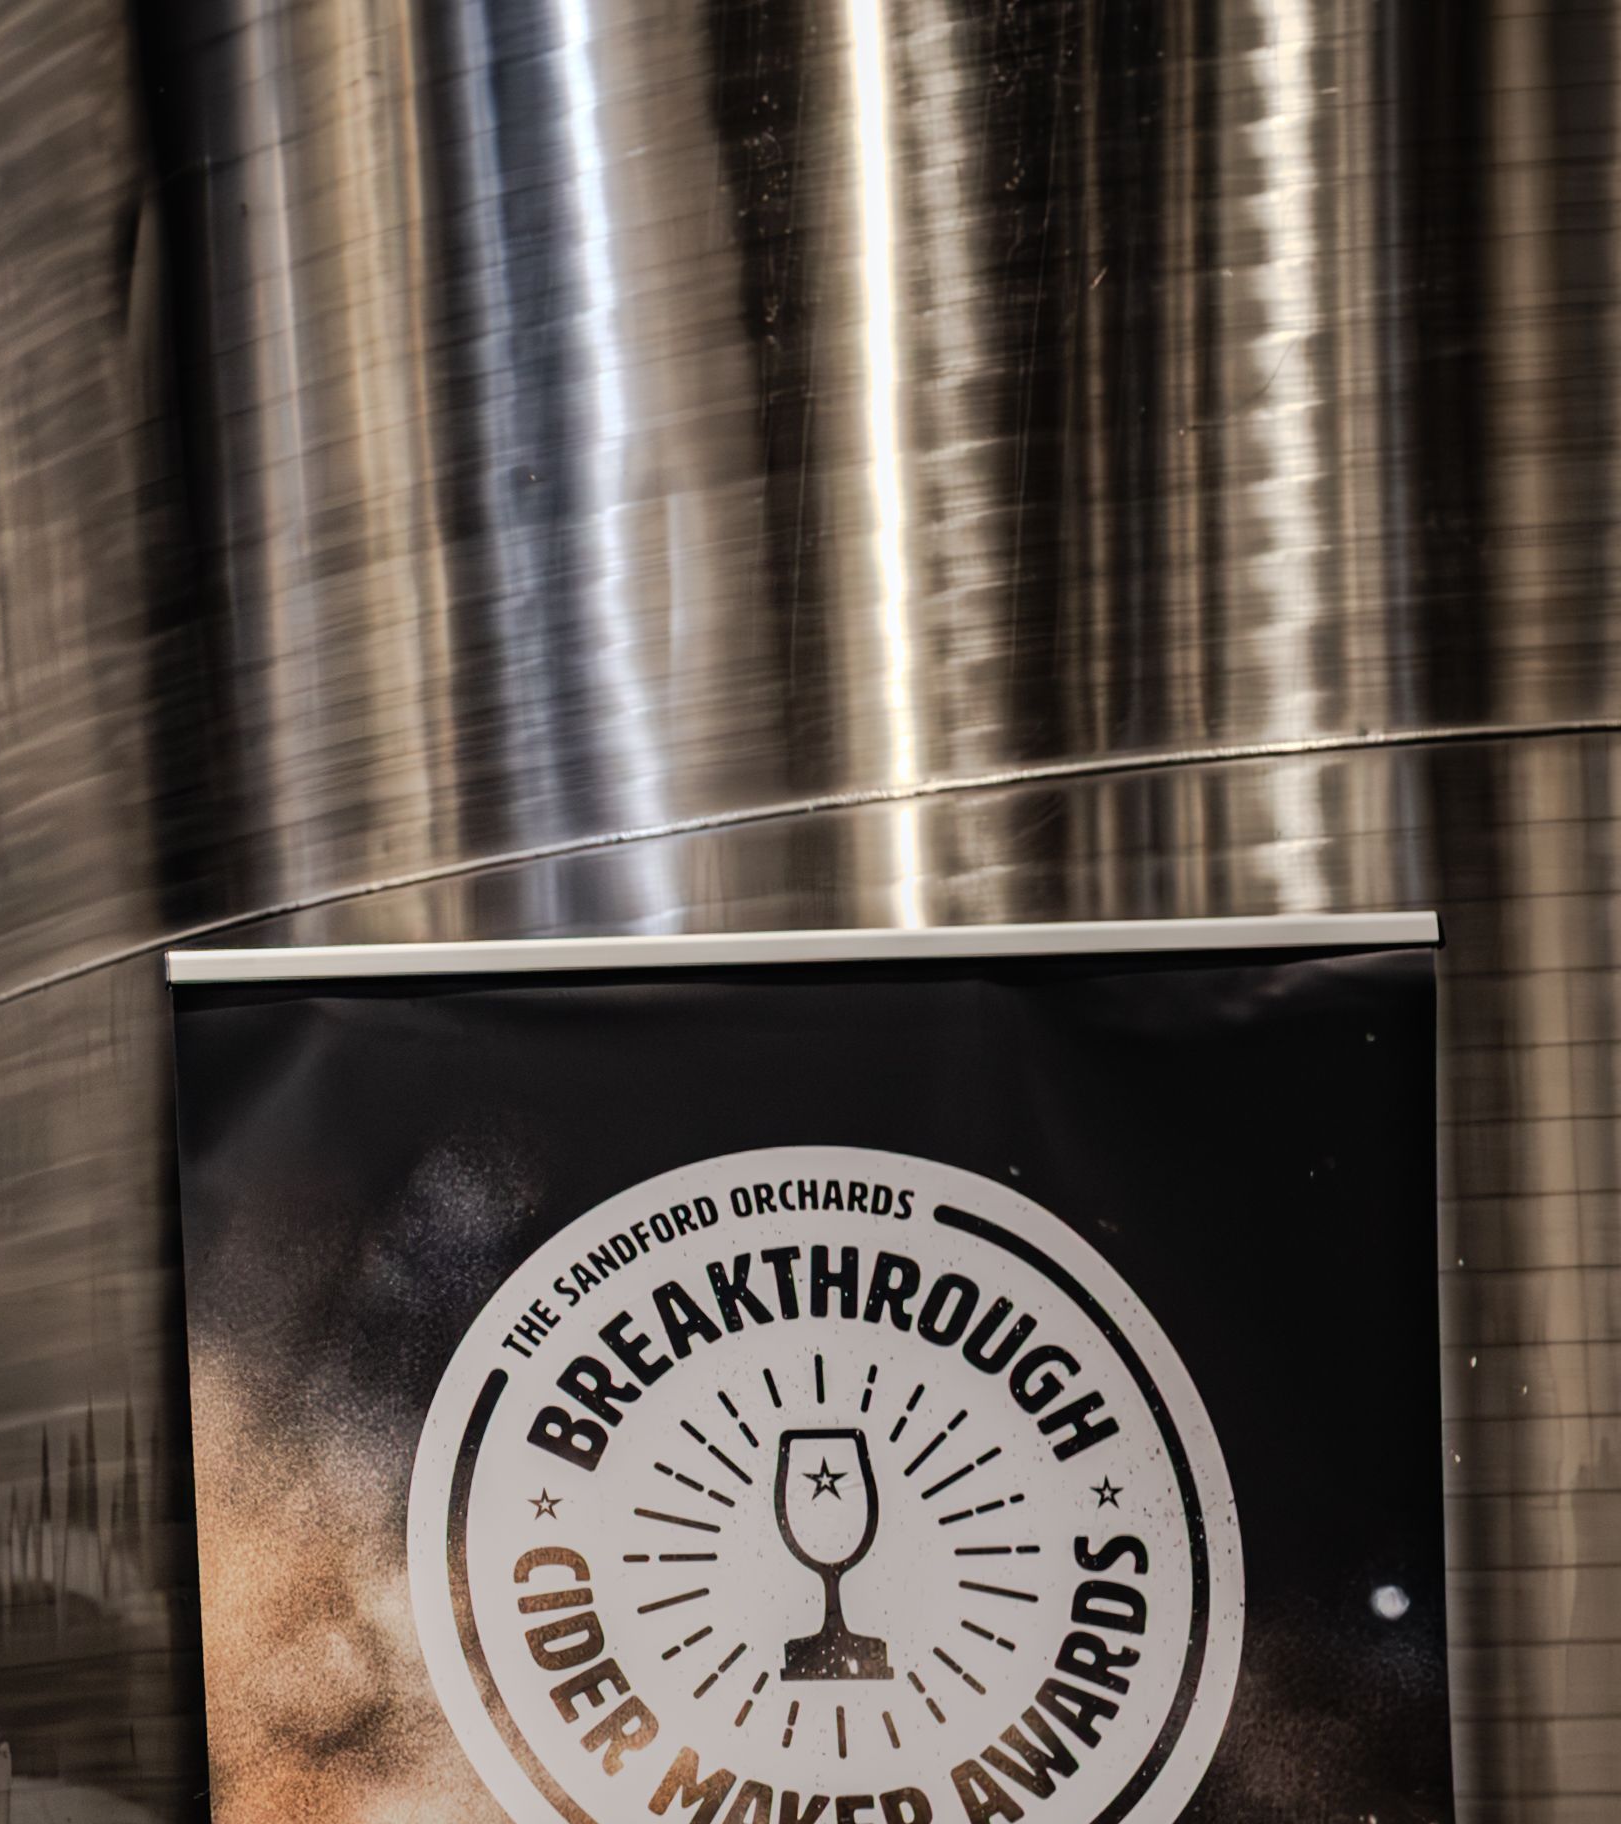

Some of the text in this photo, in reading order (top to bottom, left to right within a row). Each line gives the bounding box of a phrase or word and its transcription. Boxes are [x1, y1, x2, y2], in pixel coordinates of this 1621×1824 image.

[501, 1179, 915, 1358] THE SANDFORD ORCHARDS
[526, 1245, 1120, 1472] BREAKTHROUGH
[513, 1546, 660, 1776] CIDER
